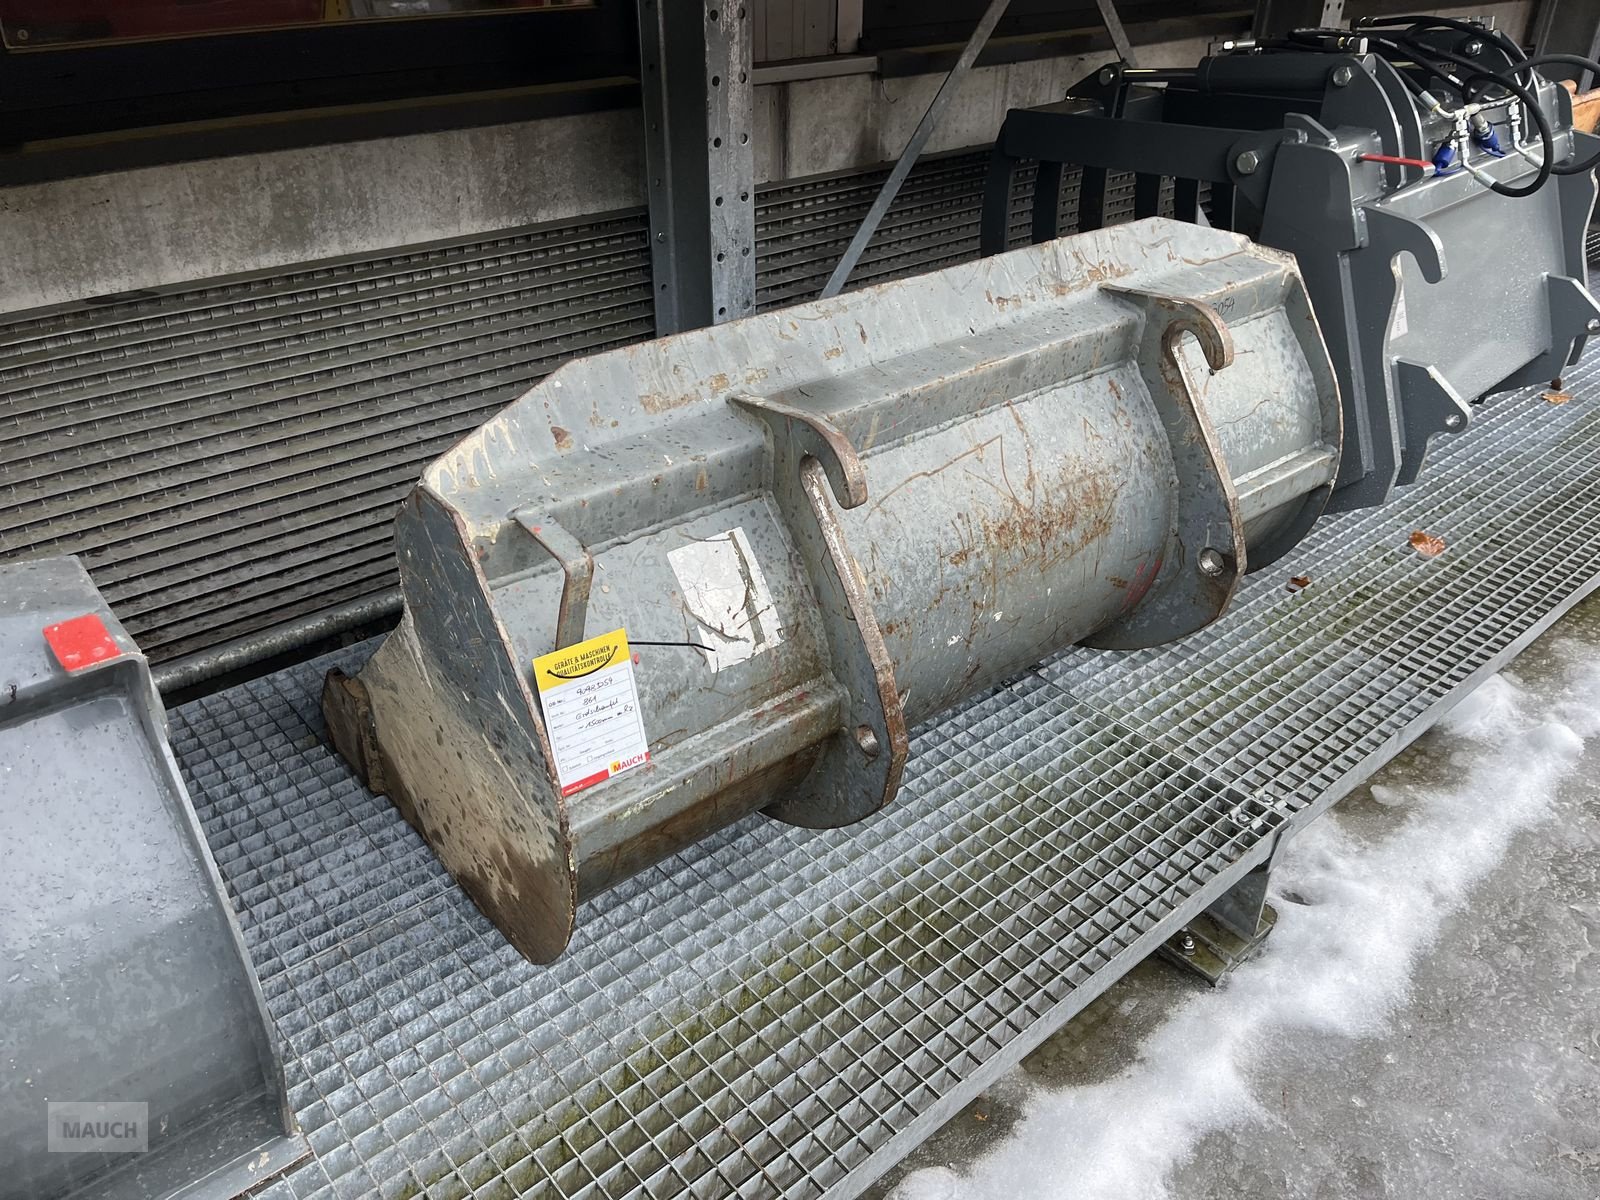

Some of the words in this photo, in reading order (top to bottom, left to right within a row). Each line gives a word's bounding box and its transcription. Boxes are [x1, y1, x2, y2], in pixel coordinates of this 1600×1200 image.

[554, 657, 573, 670] GERÄTE
[580, 645, 611, 661] MASCHINEN
[613, 754, 643, 773] MAUCH
